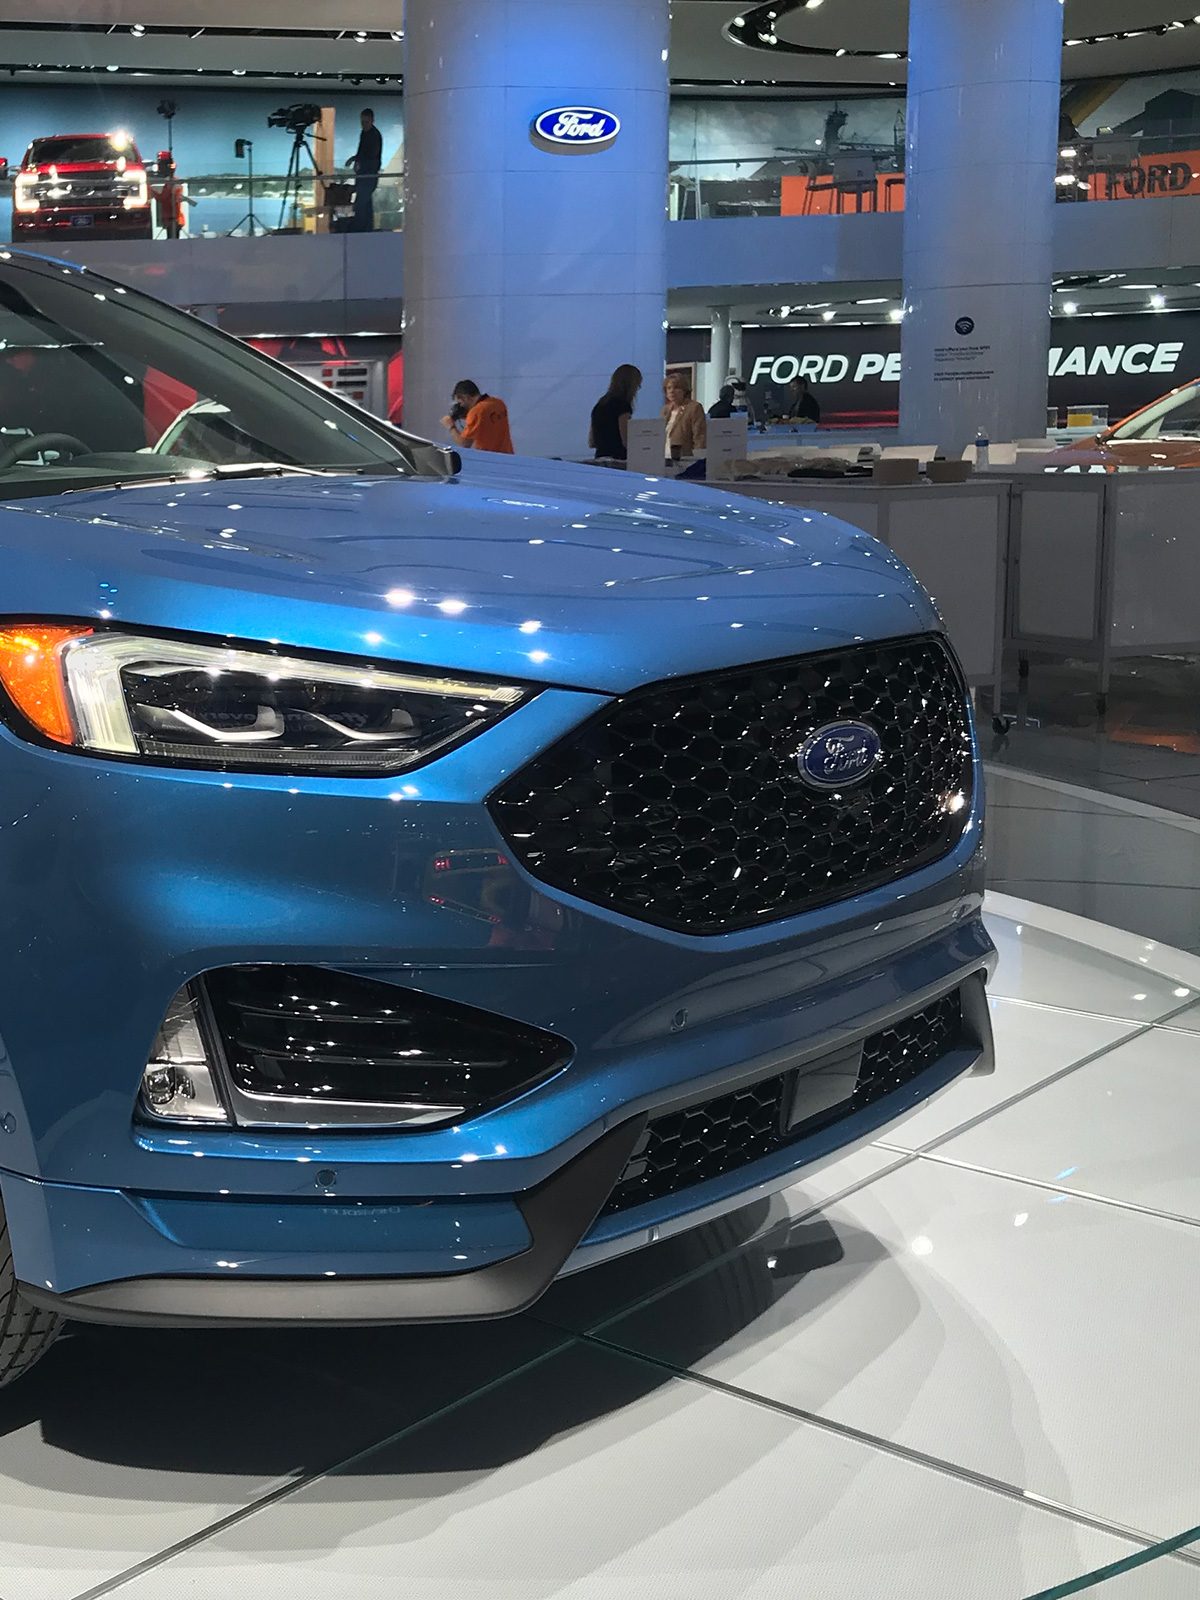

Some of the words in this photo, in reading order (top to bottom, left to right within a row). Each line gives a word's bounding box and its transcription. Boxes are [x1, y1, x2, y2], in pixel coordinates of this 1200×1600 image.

[553, 111, 606, 137] Ford
[1105, 162, 1192, 200] FORD
[749, 354, 849, 385] FORD
[823, 735, 868, 774] Ford
